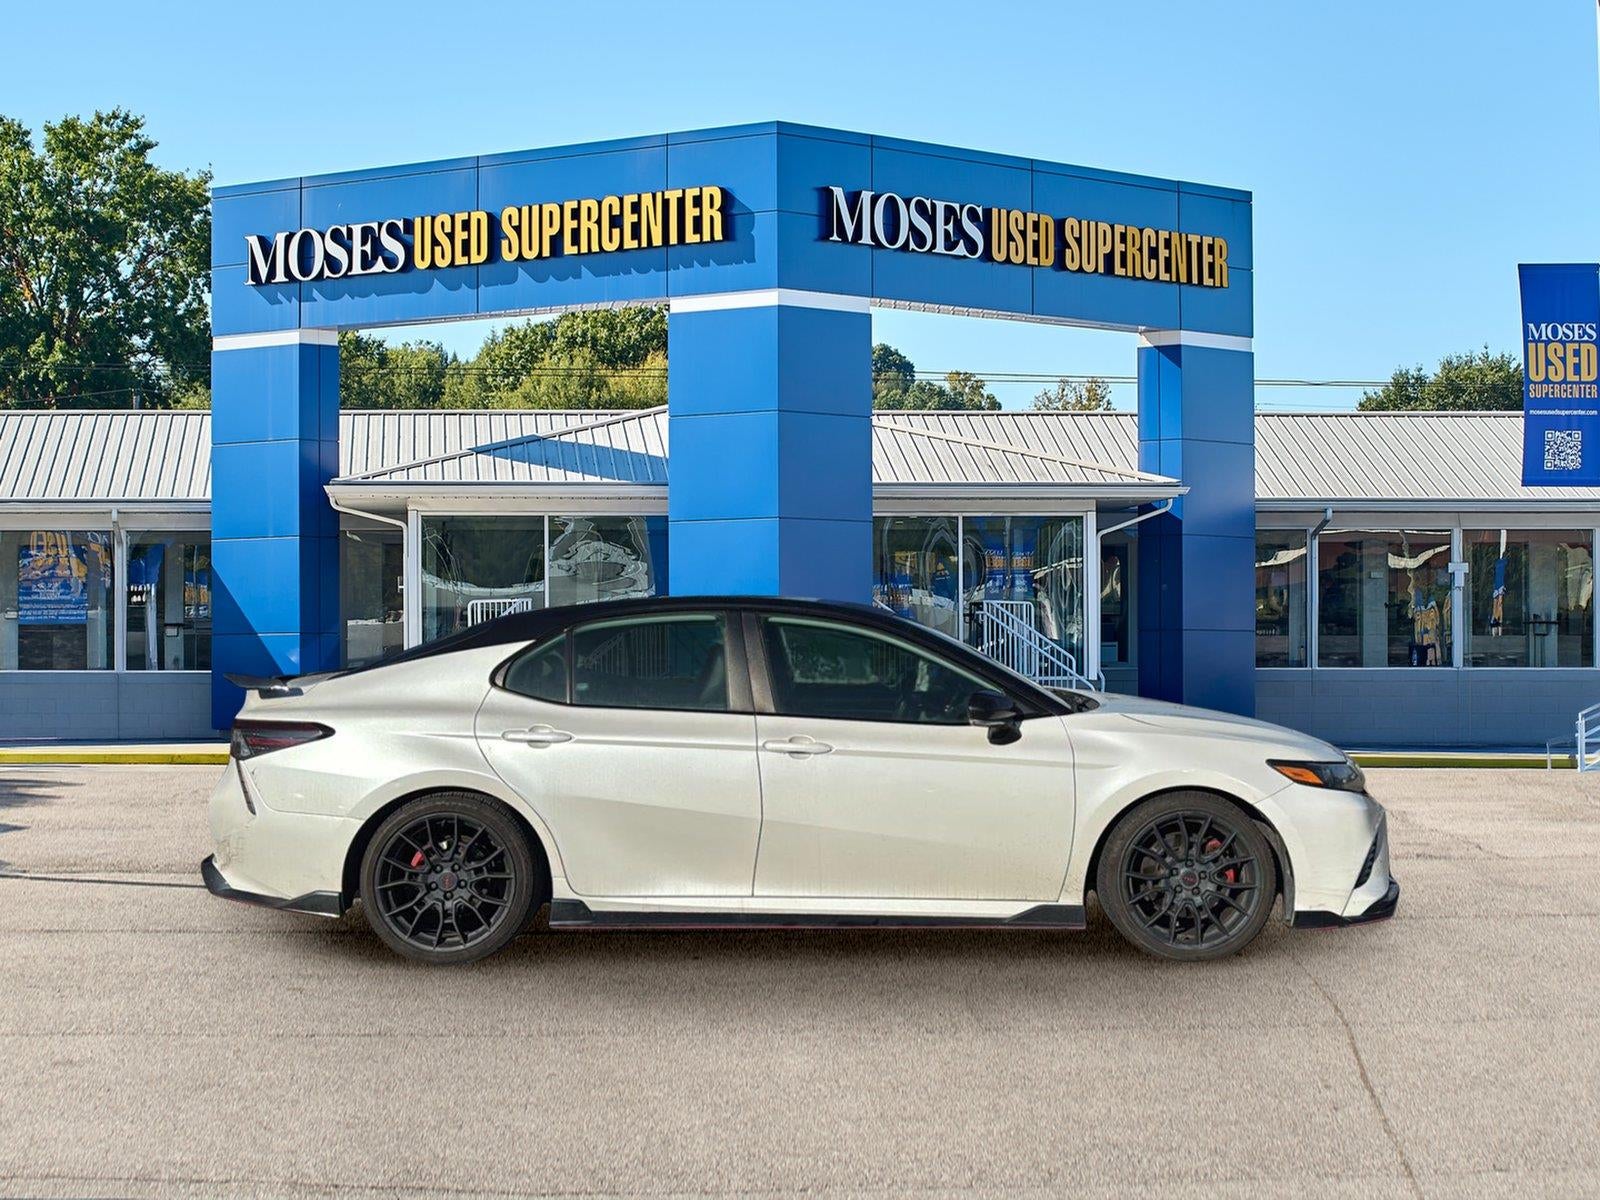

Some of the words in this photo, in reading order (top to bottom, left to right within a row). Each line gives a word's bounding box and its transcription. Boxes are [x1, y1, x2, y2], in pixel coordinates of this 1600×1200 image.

[244, 218, 407, 287] MOSES
[412, 210, 489, 271] USED
[500, 185, 724, 263] SUPERCENTER
[828, 185, 985, 259] MOSES
[990, 207, 1055, 268] USED
[1063, 216, 1229, 288] SUPERCENTER
[1527, 323, 1597, 341] MOSES
[1528, 342, 1597, 382] USED
[1529, 384, 1598, 398] SUPERCENTER
